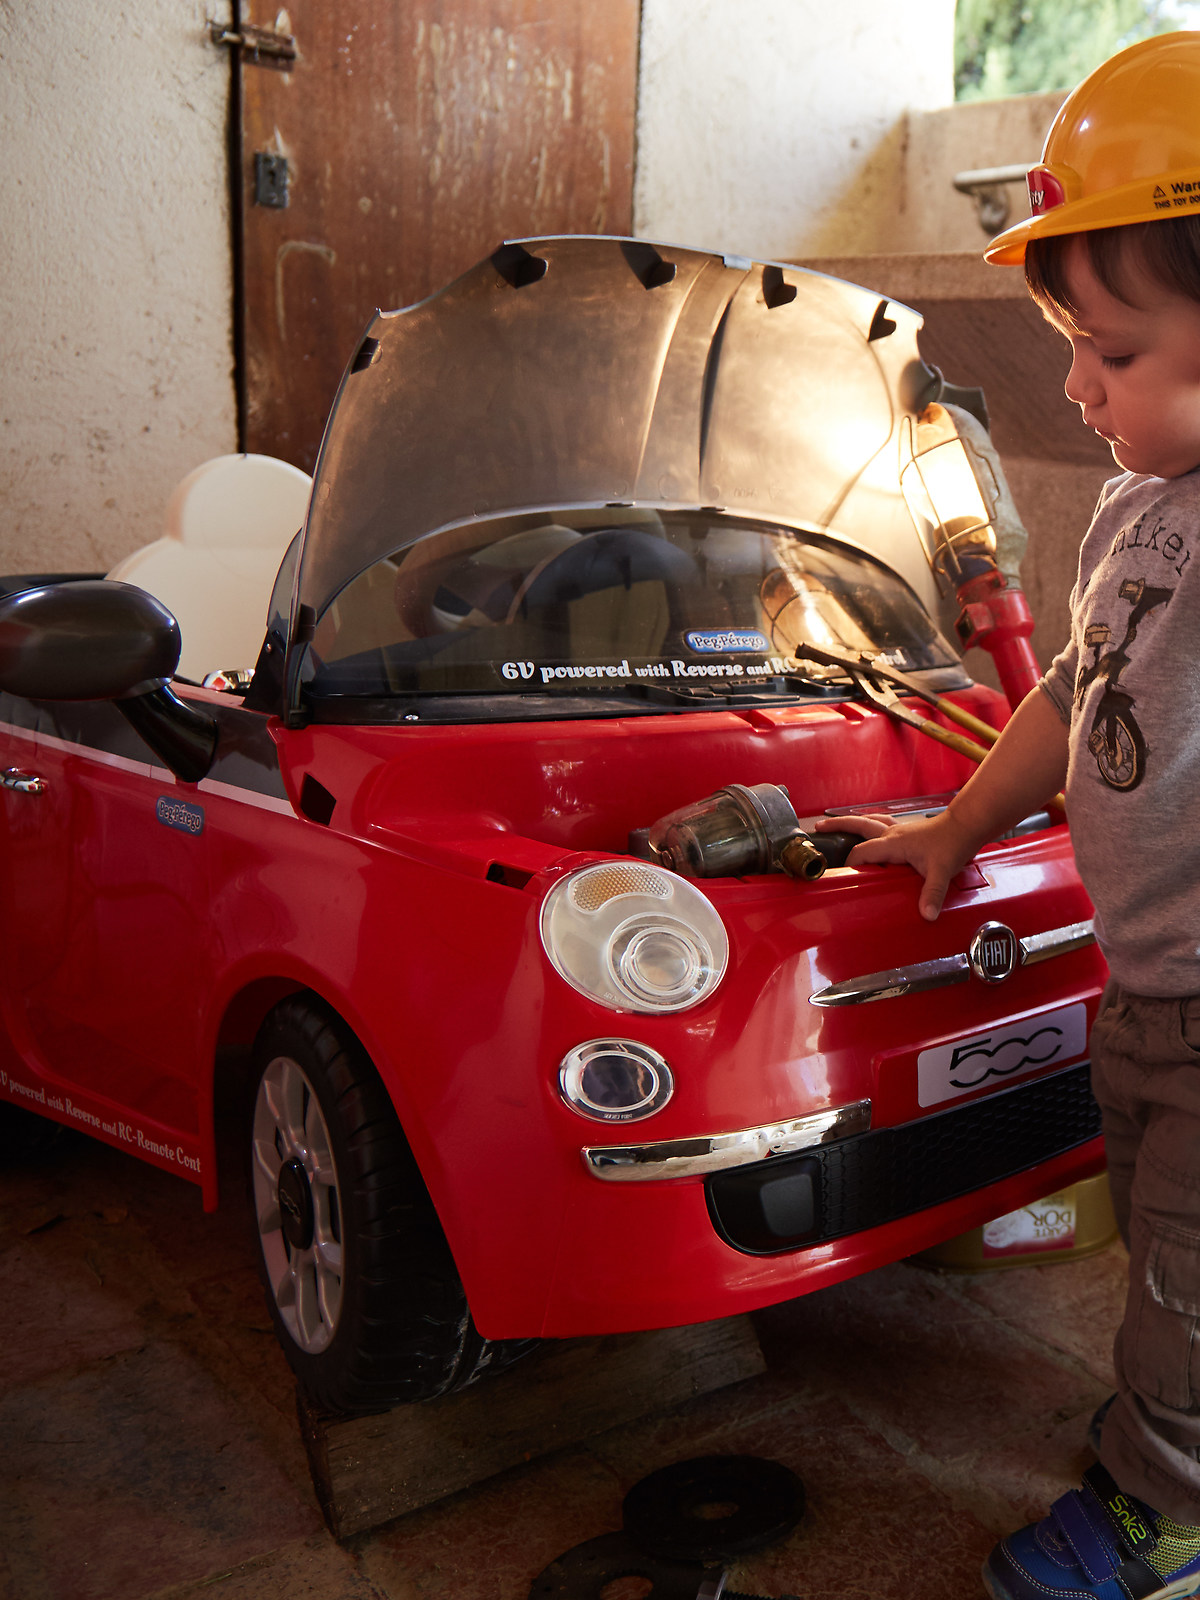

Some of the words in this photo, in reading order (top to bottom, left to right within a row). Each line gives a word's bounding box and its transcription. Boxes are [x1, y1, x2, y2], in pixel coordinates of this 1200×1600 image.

[1154, 200, 1171, 209] THIS
[1173, 197, 1187, 206] TOY
[502, 661, 534, 680] 6V
[541, 660, 632, 683] powered
[635, 663, 670, 677] with
[672, 660, 743, 677] Reverse
[747, 661, 772, 675] and
[984, 938, 1007, 967] FIAT
[949, 1026, 1064, 1089] 500
[9, 1078, 45, 1104] powered
[46, 1095, 64, 1112] with
[65, 1097, 101, 1128] Reverse
[101, 1121, 117, 1136] and
[118, 1121, 175, 1161] RC-Remote
